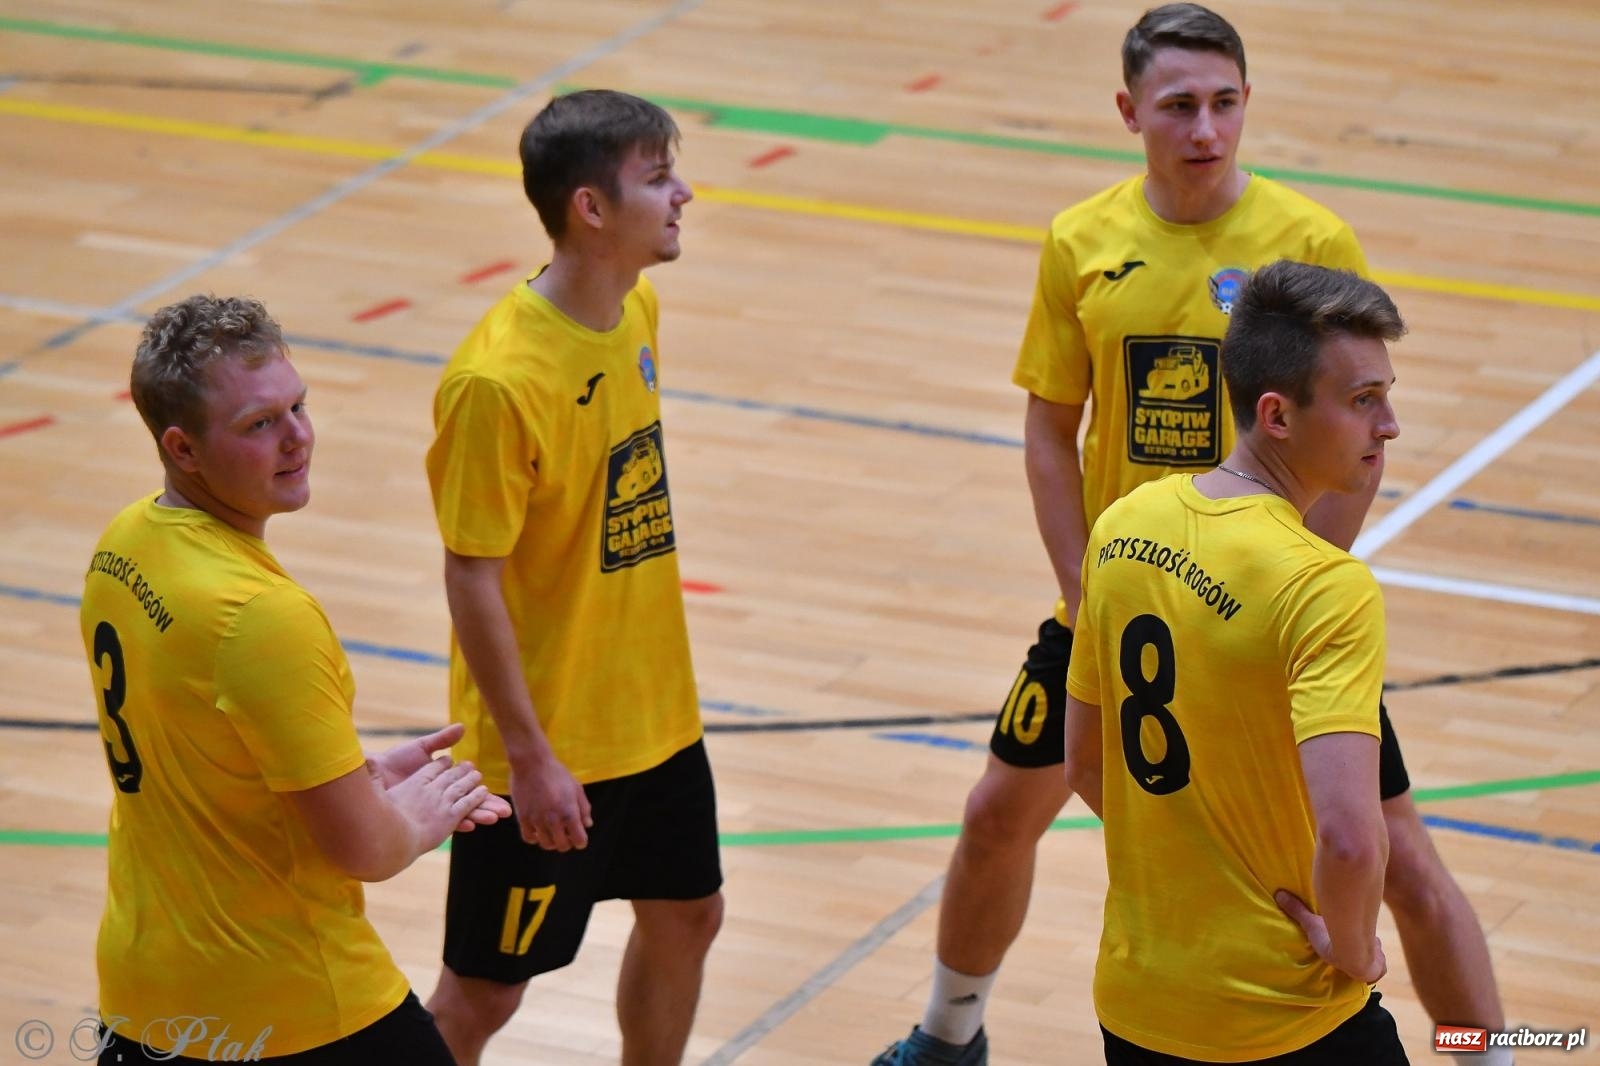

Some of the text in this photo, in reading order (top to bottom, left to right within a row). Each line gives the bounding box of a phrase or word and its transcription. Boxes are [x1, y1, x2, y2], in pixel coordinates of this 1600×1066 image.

[1135, 407, 1211, 429] STOPIW
[1135, 426, 1211, 448] GARAGE
[131, 573, 174, 634] ROGÓW
[1097, 537, 1242, 622] PRZYSZŁOŚĆ ROGÓW
[93, 620, 143, 794] 3
[1000, 669, 1048, 746] 10
[1119, 613, 1191, 796] 8
[500, 883, 557, 956] 17
